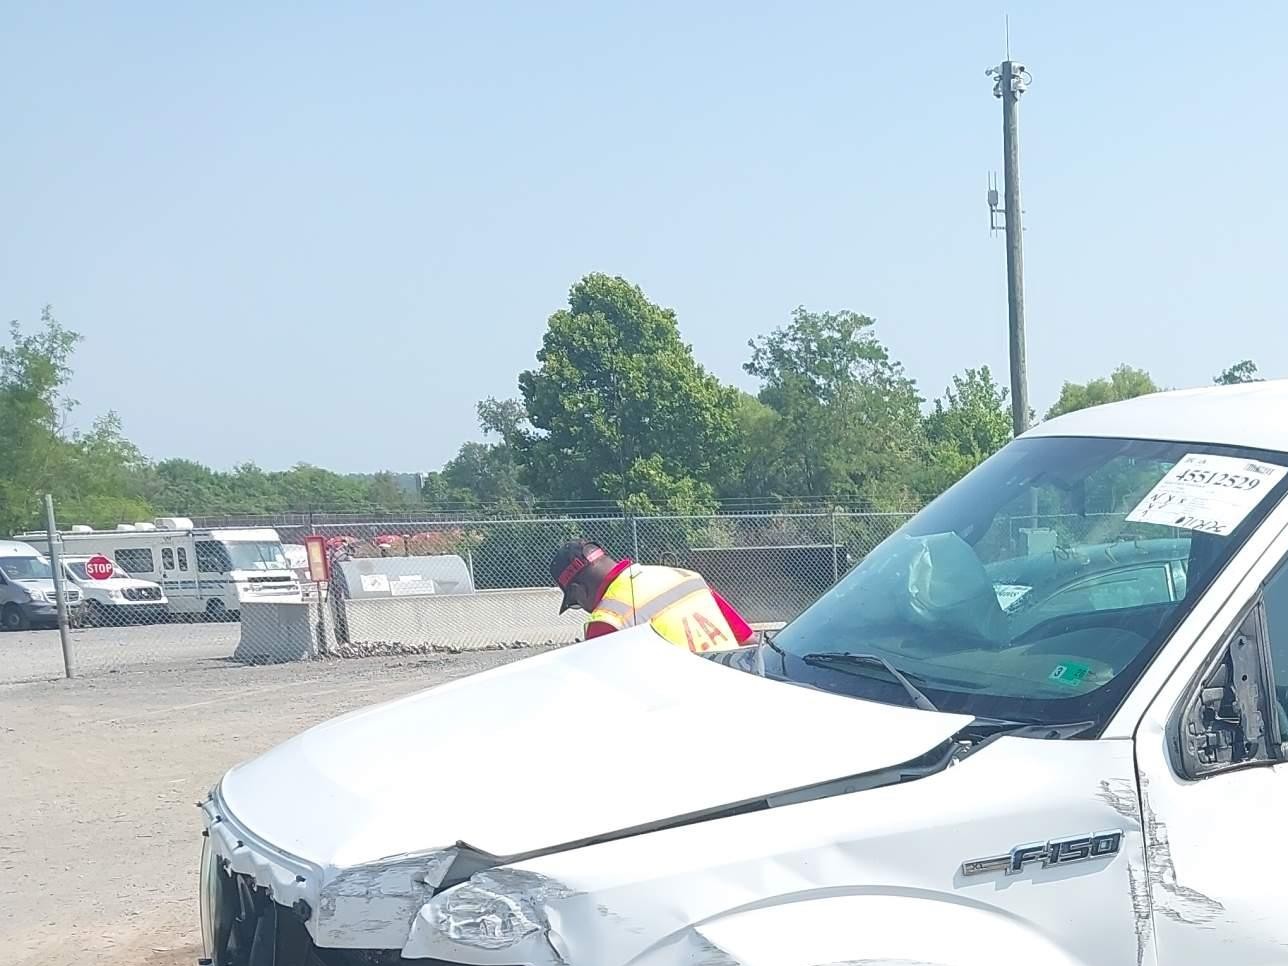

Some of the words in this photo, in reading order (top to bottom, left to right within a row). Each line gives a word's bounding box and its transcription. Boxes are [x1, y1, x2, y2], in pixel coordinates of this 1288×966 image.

[1176, 468, 1261, 491] 45512529
[87, 563, 112, 574] STOP
[1009, 829, 1122, 875] F-150
